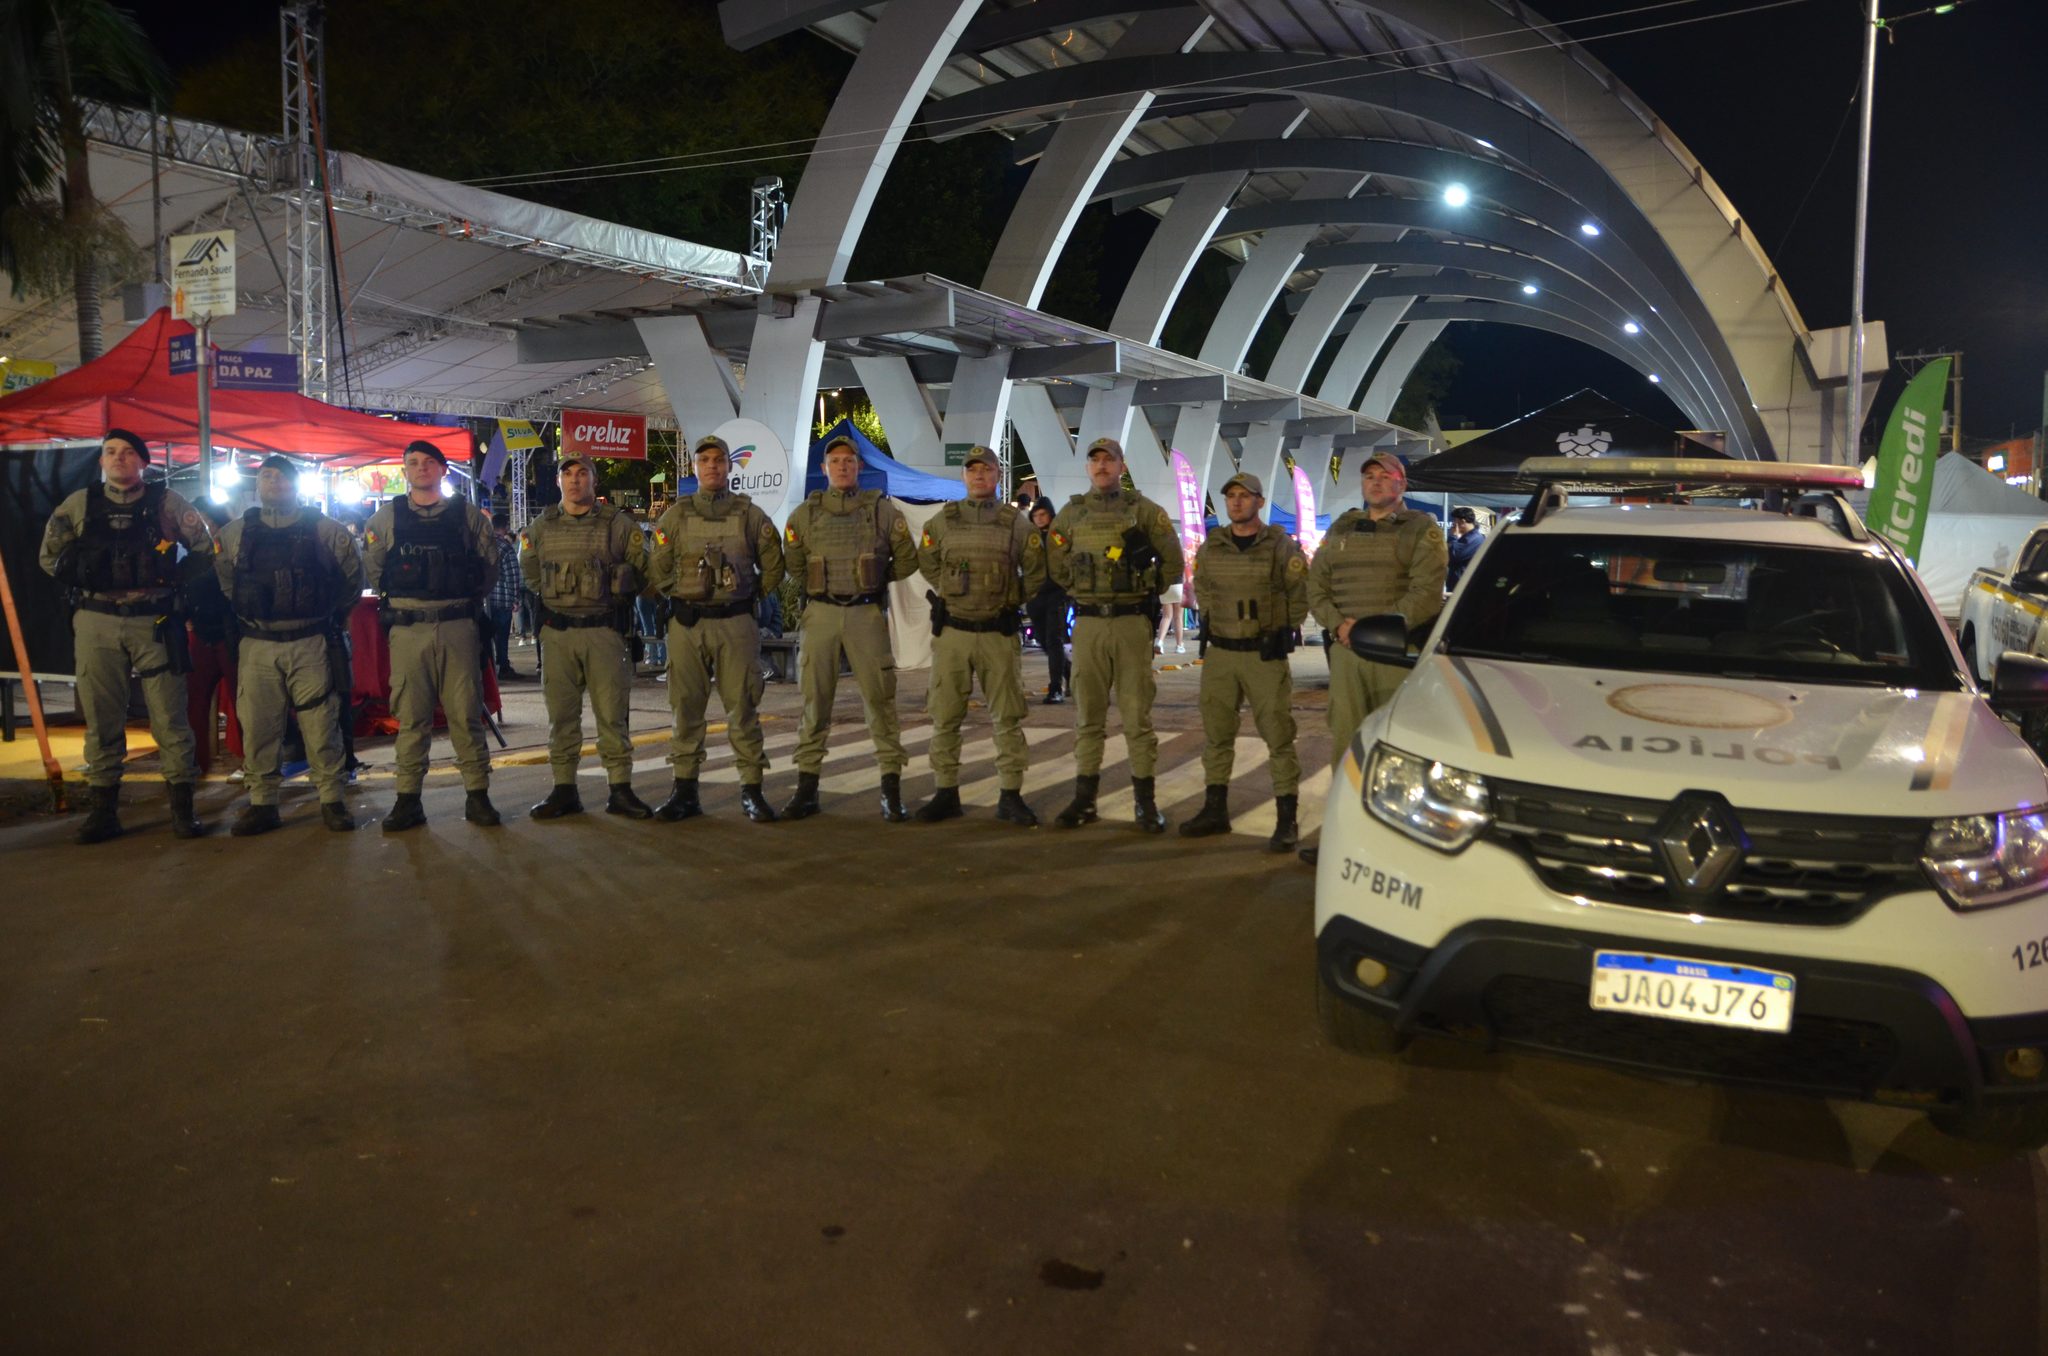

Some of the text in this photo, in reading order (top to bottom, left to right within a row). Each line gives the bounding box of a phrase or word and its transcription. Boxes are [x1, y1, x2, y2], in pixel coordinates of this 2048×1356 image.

[174, 264, 232, 279] Fernanda Sauer
[180, 349, 191, 361] PAZ
[218, 354, 243, 363] PRAÇA
[219, 365, 273, 379] DA PAZ
[507, 428, 534, 438] SILVA
[574, 419, 631, 444] creluz
[1676, 965, 1710, 978] BRASIL
